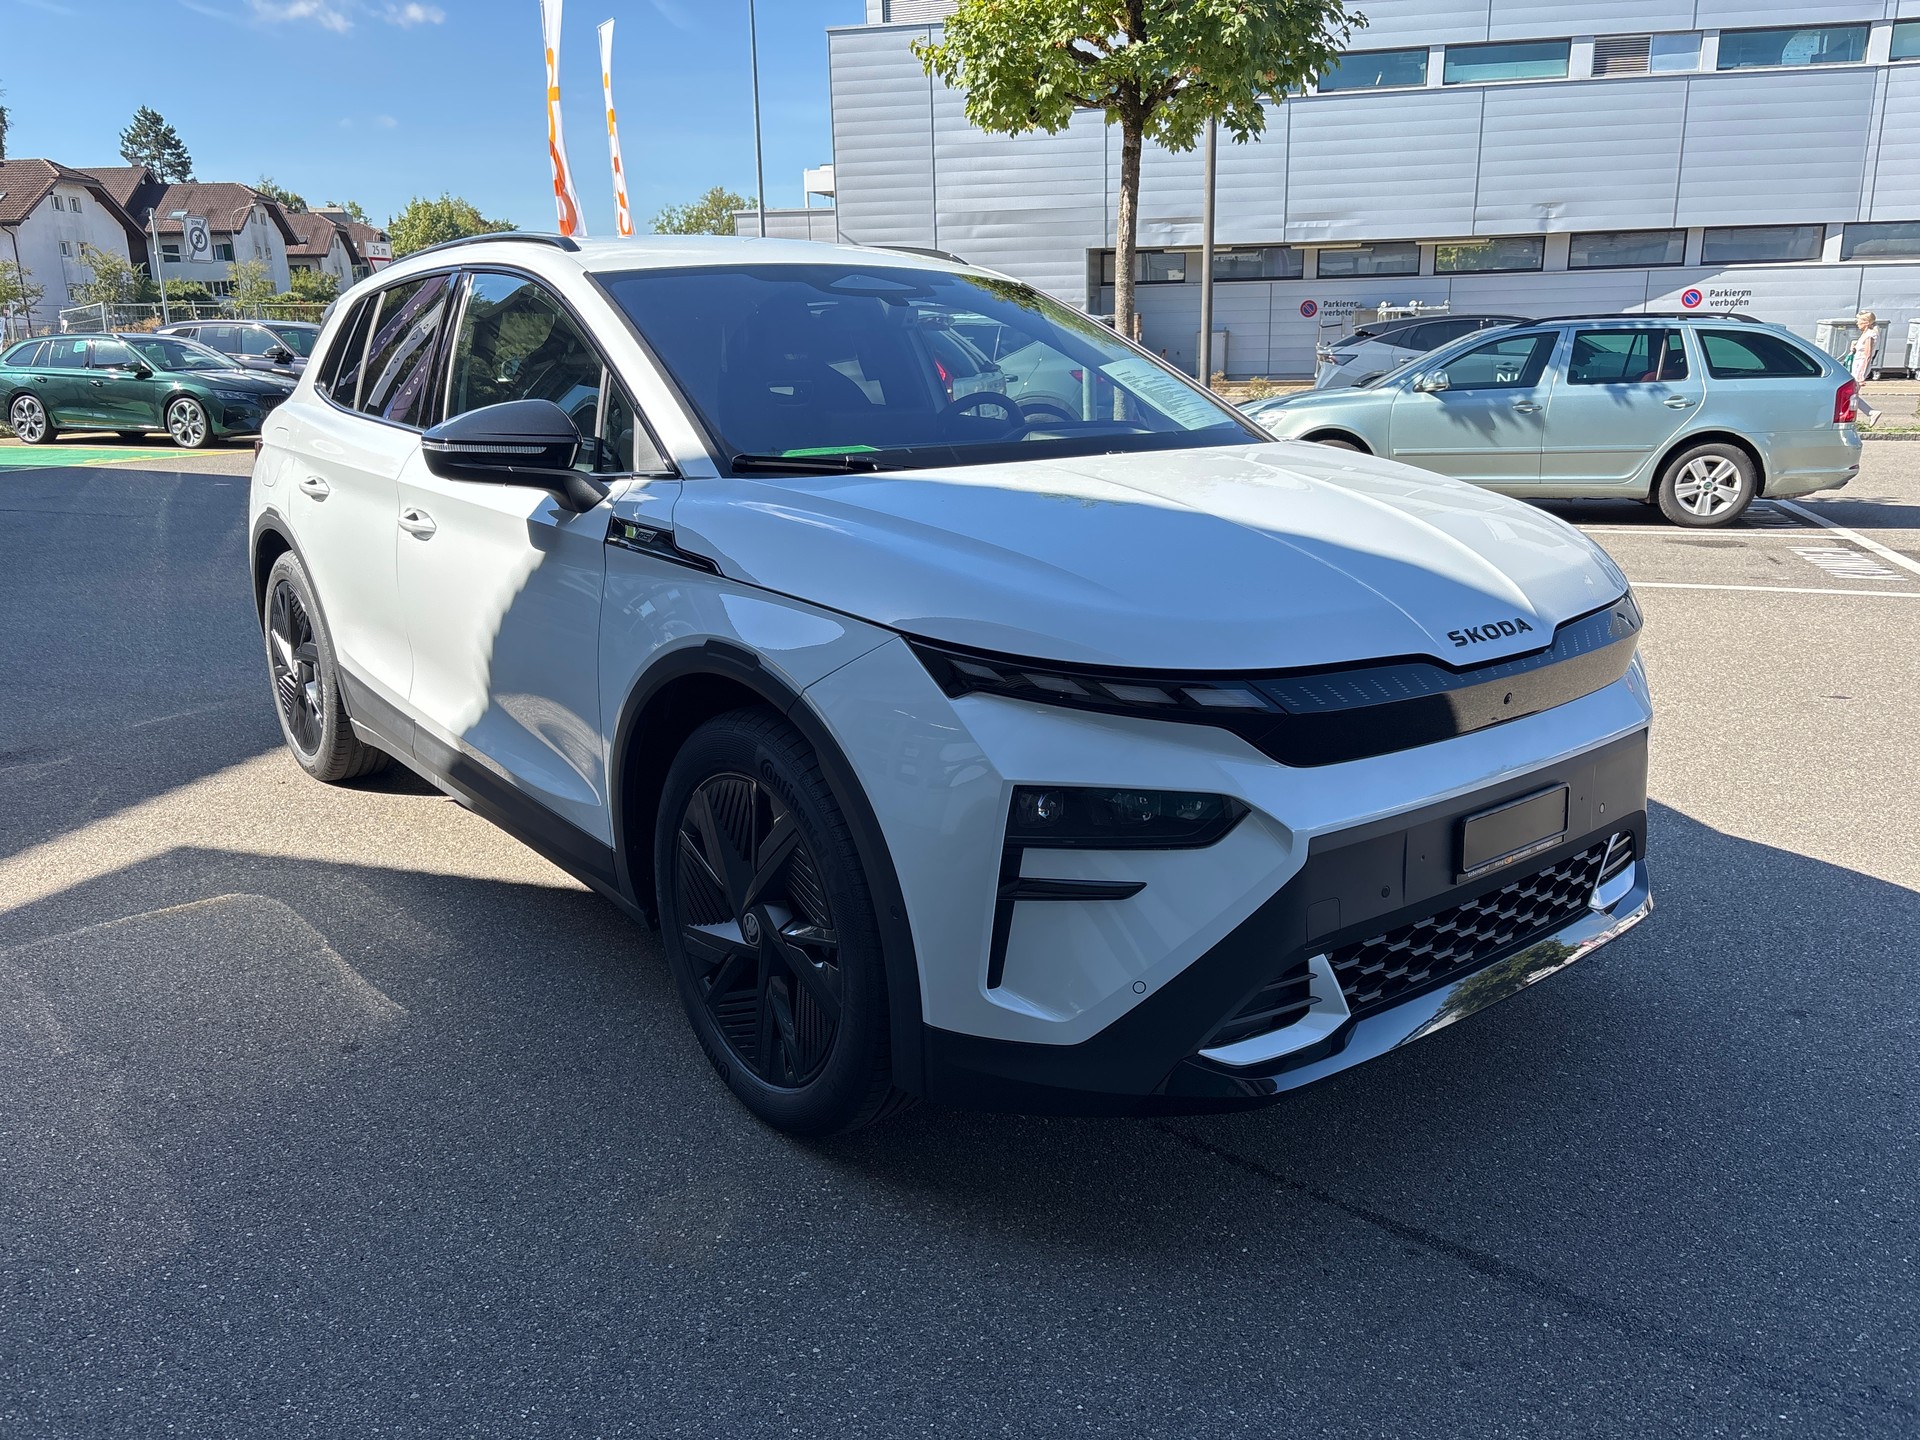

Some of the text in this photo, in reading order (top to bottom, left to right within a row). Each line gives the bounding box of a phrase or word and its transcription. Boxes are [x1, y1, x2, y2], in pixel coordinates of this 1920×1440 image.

[372, 245, 380, 255] 25
[1710, 288, 1752, 297] Parkieren
[1710, 298, 1750, 306] verboten
[1446, 617, 1533, 648] SKODA
[759, 758, 831, 860] Continental
